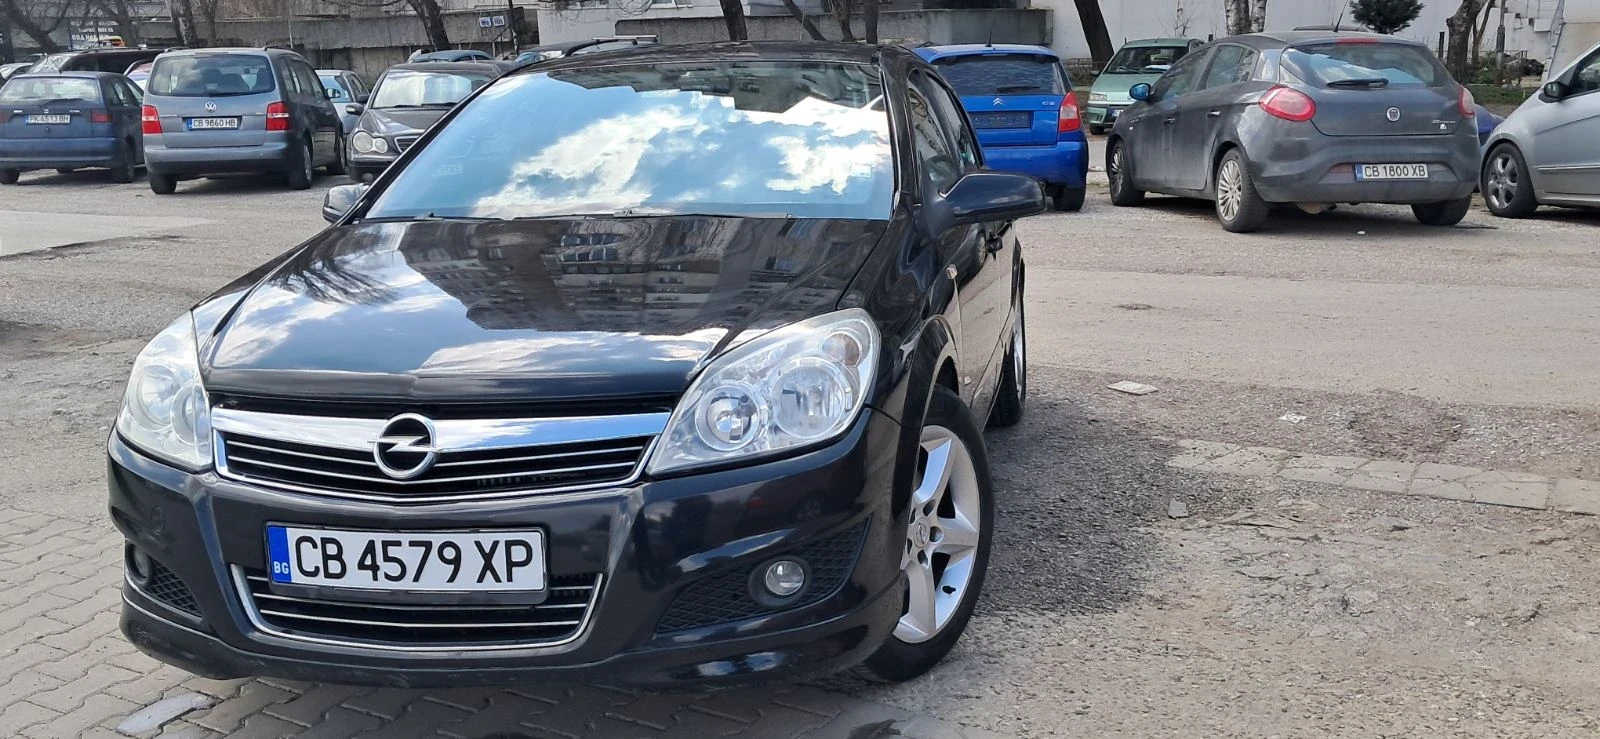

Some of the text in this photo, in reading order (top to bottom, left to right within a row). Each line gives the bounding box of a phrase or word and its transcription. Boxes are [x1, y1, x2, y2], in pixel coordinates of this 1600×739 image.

[1364, 165, 1426, 177] CB 1800 XB
[294, 535, 534, 584] CB 4579 XP
[273, 560, 290, 575] BG
